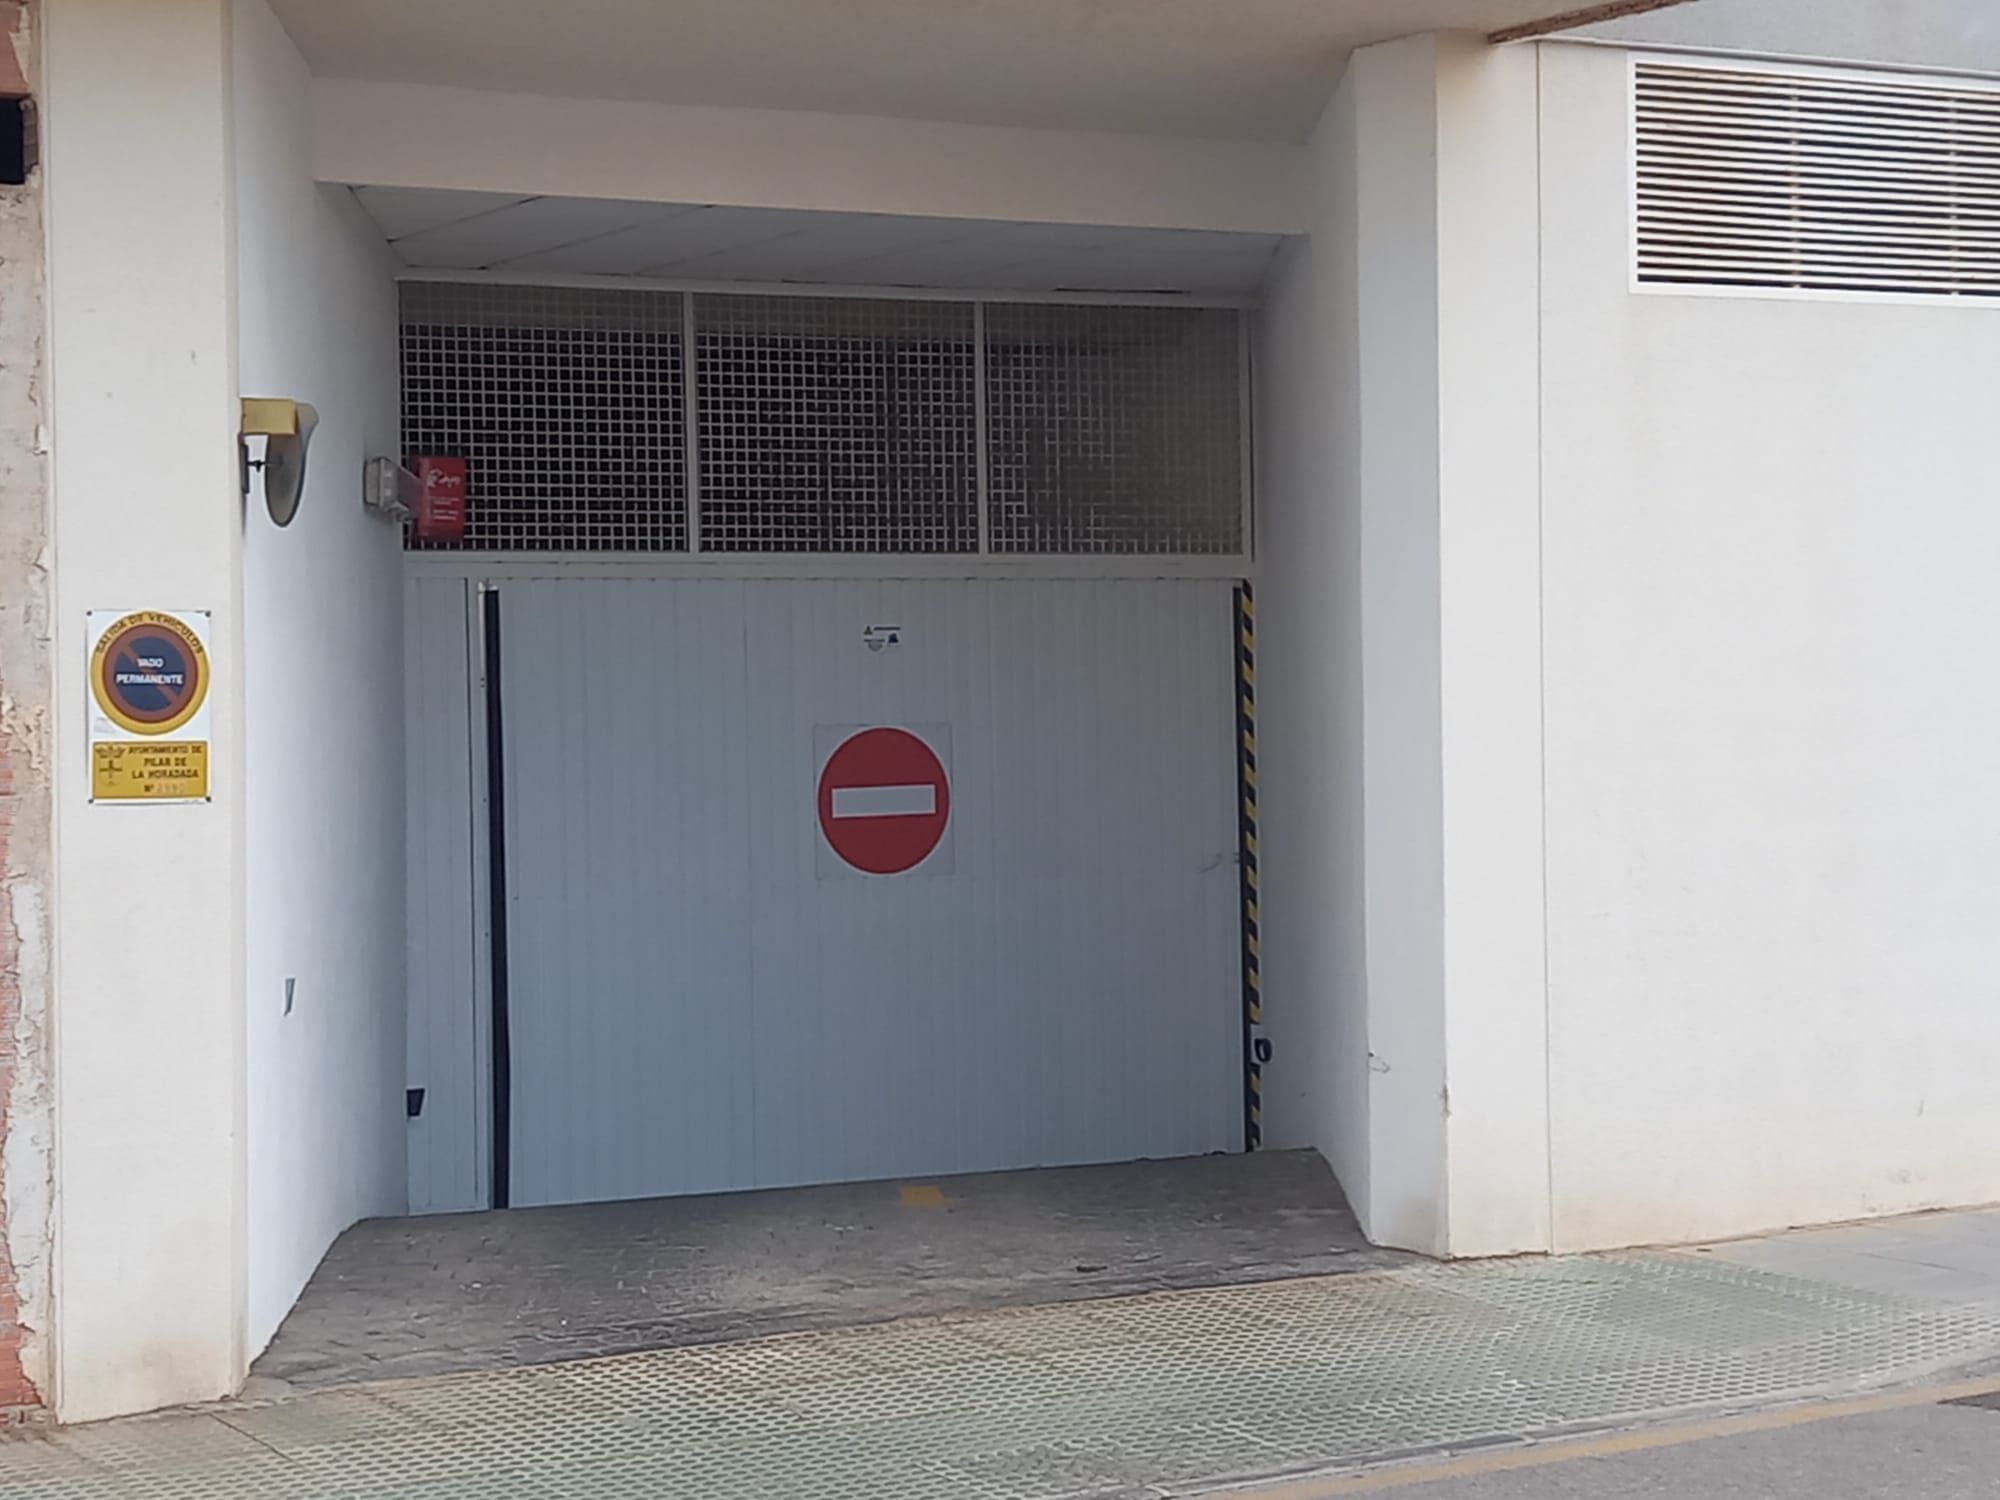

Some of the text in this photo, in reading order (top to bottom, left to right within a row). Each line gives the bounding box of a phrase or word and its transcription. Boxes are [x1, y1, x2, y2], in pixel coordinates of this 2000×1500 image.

[128, 613, 144, 626] DE
[137, 658, 164, 668] VADO
[116, 673, 184, 685] PERMANENTE
[127, 745, 203, 754] AYUNTAMIENTO DE
[144, 757, 187, 767] PILAR DE
[132, 769, 199, 779] LA HORADADA
